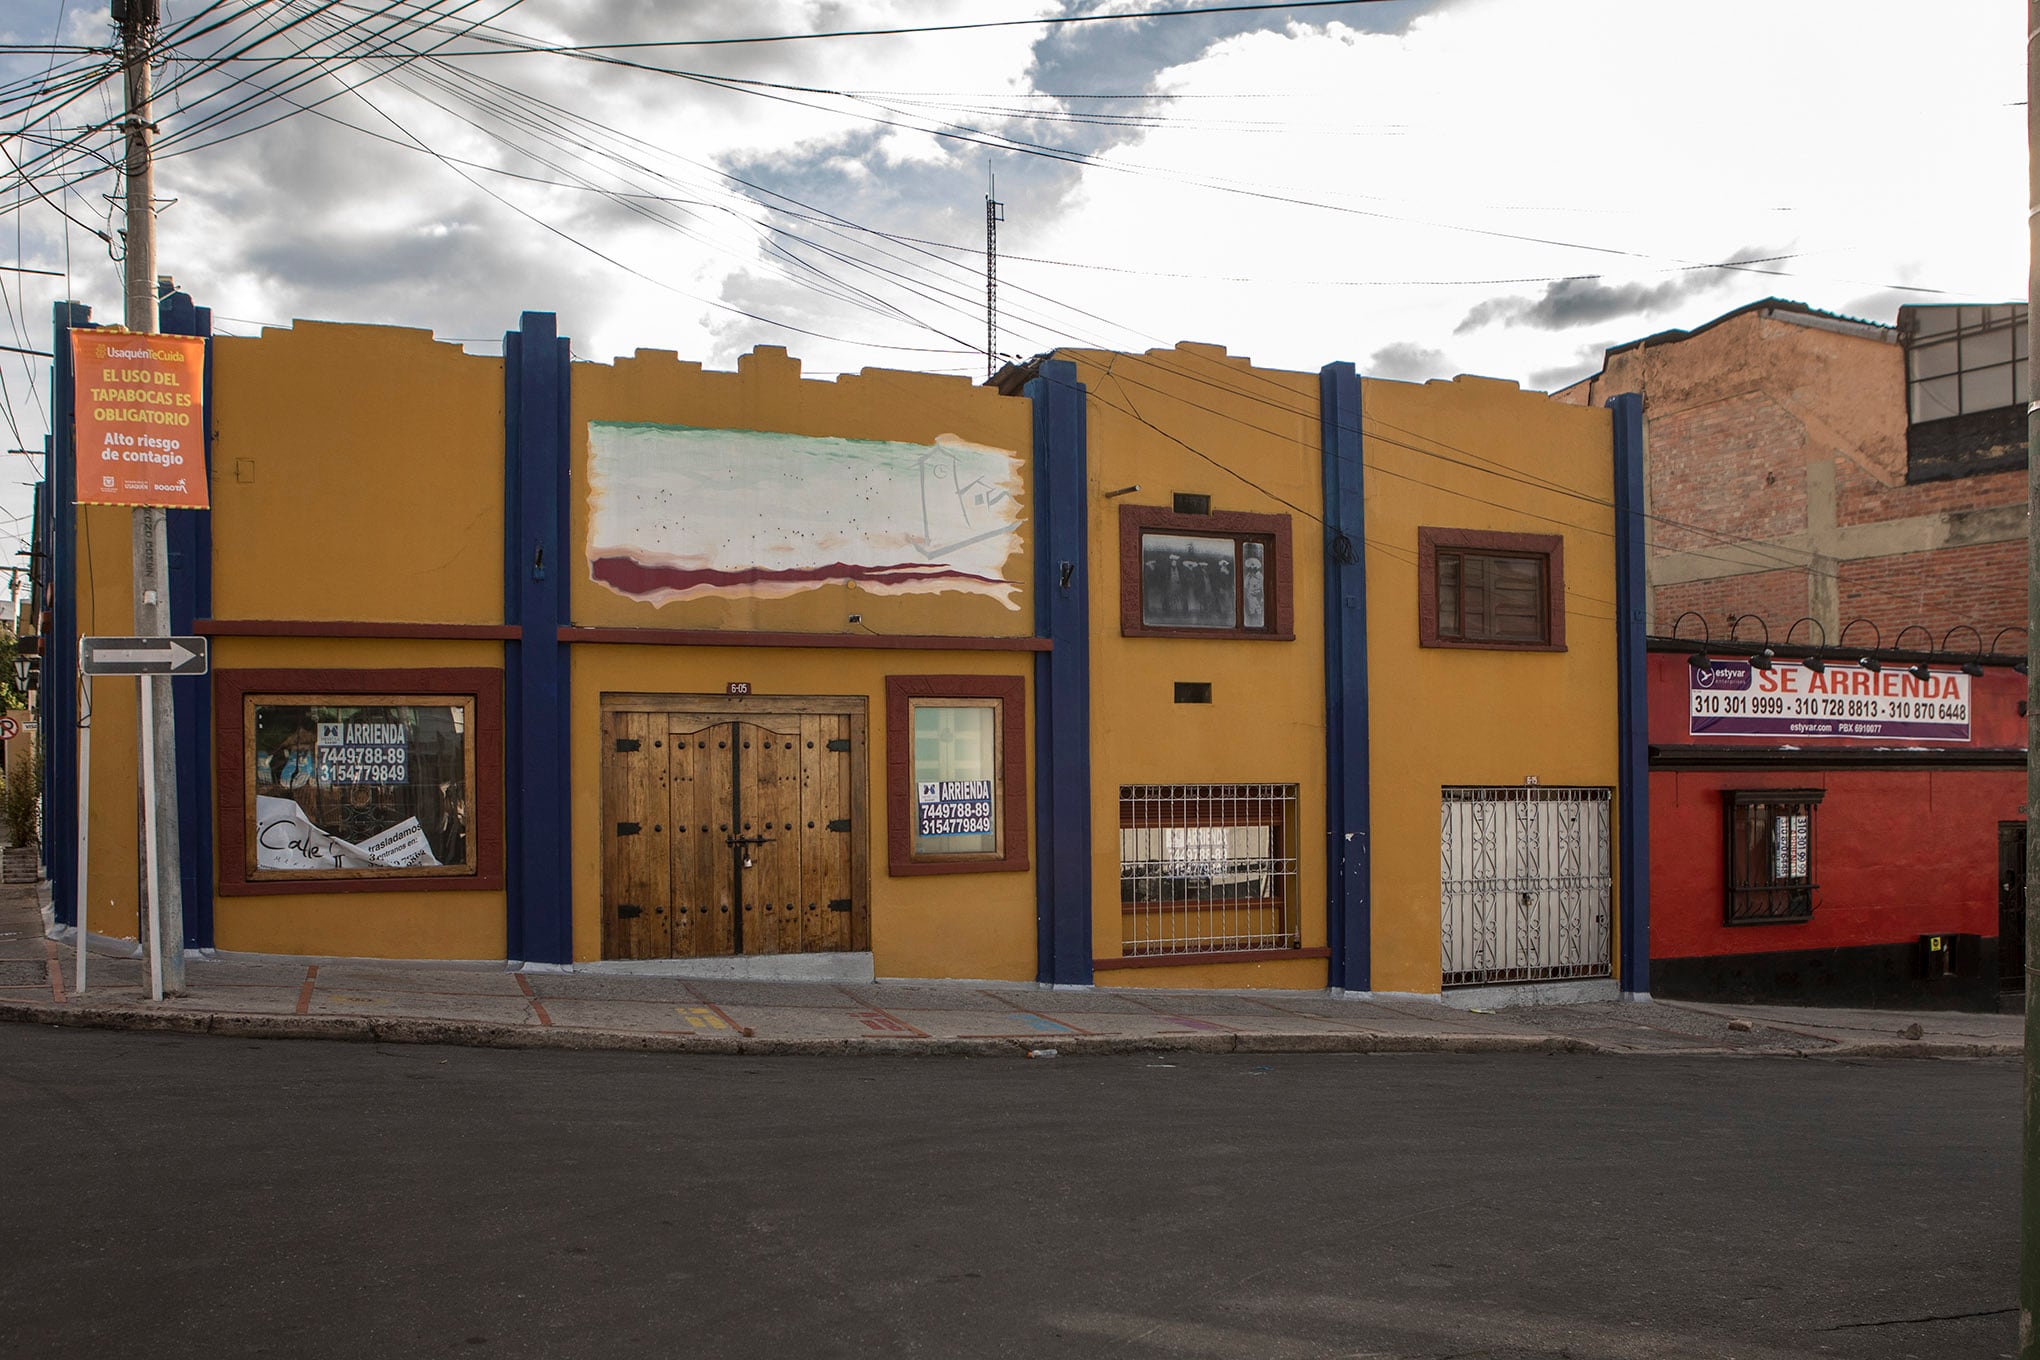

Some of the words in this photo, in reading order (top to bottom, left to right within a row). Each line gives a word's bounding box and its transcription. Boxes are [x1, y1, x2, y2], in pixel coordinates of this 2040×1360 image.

[96, 344, 184, 362] #UsaquénTeCuida
[103, 369, 119, 382] EL
[121, 370, 151, 383] USO
[154, 372, 179, 386] DEL
[91, 388, 172, 405] TAPABOCAS
[175, 393, 191, 407] ES
[94, 408, 190, 426] OBLIGATORIO
[104, 432, 134, 446] Alto
[137, 434, 180, 452] riesgo
[101, 448, 119, 461] de
[122, 450, 183, 467] contagio
[1715, 668, 1746, 680] estyvar
[731, 683, 747, 693] 6-05
[1759, 668, 1798, 693] SE
[1808, 669, 1960, 700] ARRIENDA
[1695, 695, 1719, 713] 310
[1724, 696, 1746, 714] 301
[1752, 696, 1783, 714] 9999
[1795, 697, 1818, 716] 310
[1822, 698, 1844, 716] 728
[1848, 700, 1877, 717] 8813
[1889, 701, 1910, 719] 310
[1914, 702, 1935, 719] 870
[1939, 703, 1966, 720] 6448
[346, 723, 405, 745] ARRIENDA
[1790, 723, 1832, 733] estyvar.com
[1838, 723, 1854, 733] PBX
[1855, 723, 1882, 733] 6910077
[320, 765, 405, 781] 3154779849
[942, 781, 989, 800] ARRIENDA
[921, 802, 990, 819] 7449788-89
[922, 818, 990, 835] 3154779849
[1797, 818, 1807, 834] 310
[368, 824, 422, 853] trasladamos
[1797, 835, 1807, 850] 301
